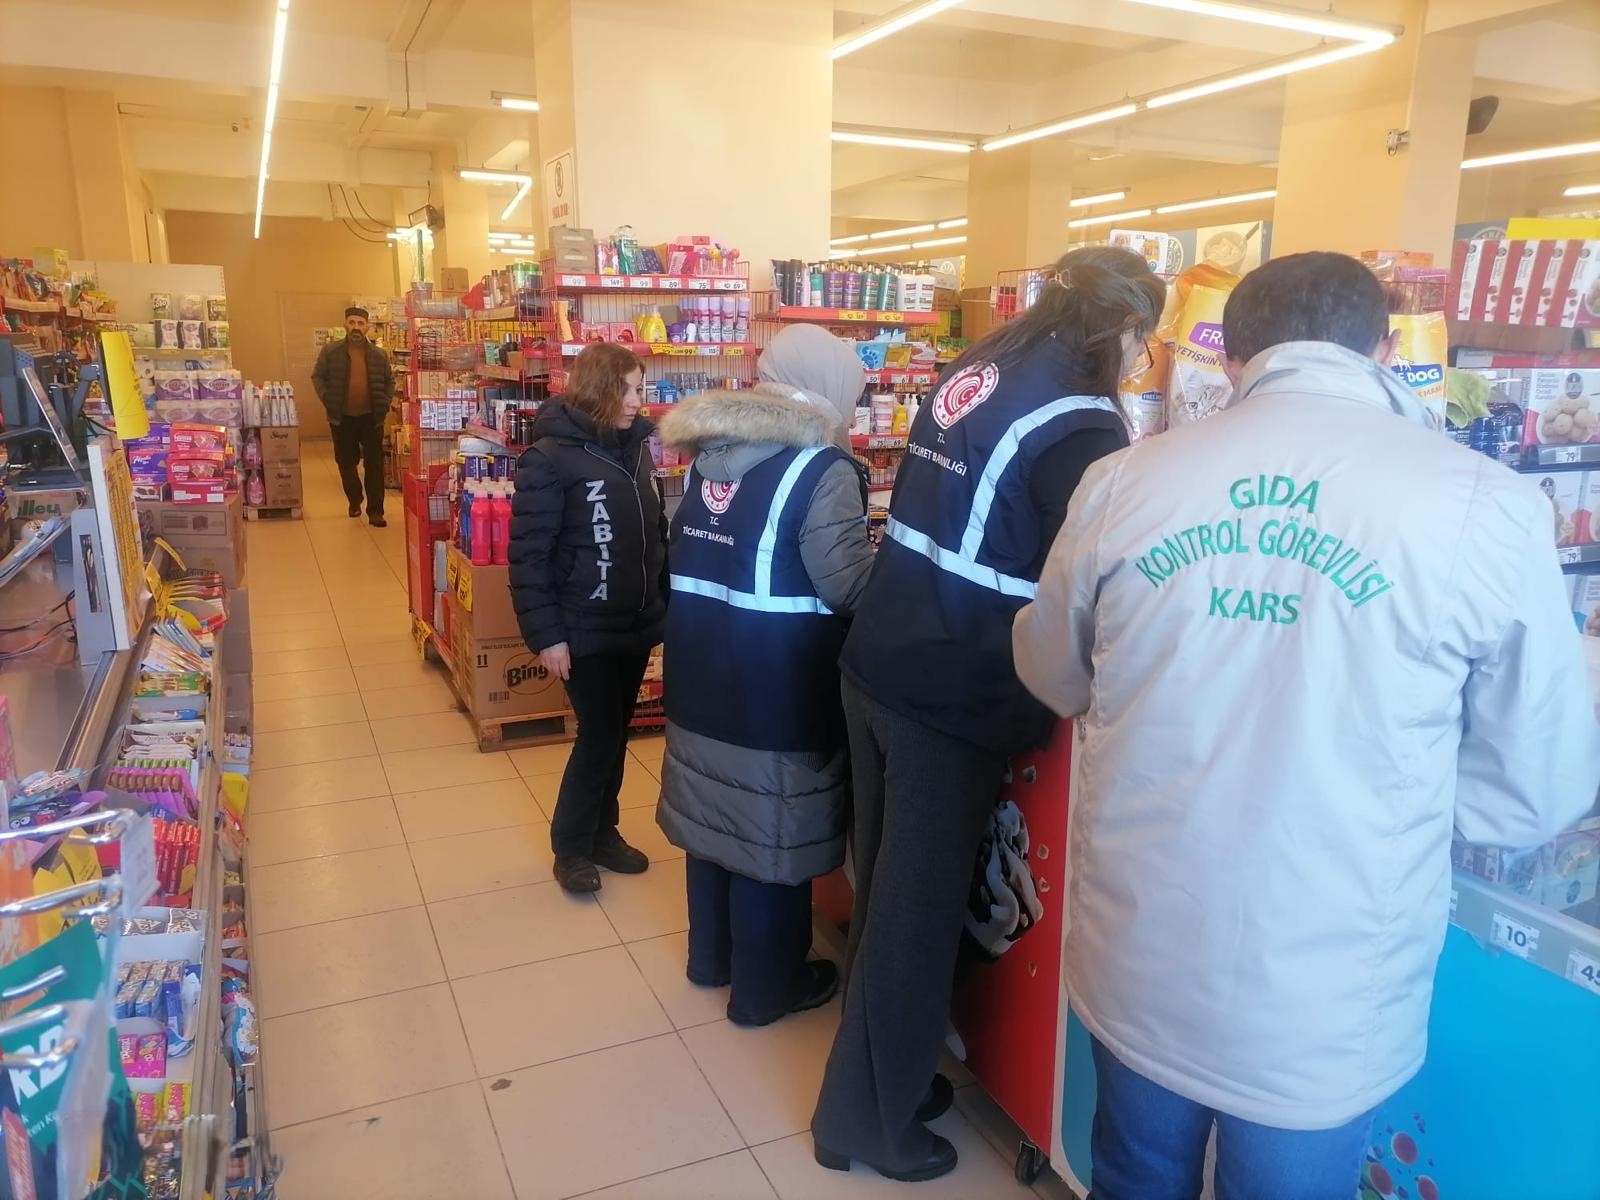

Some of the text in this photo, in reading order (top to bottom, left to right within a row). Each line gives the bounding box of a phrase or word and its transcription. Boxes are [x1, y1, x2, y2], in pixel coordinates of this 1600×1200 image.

[1407, 368, 1440, 383] DOG
[931, 451, 968, 477] BANLIĞI
[1229, 474, 1321, 514] GIDA
[585, 480, 614, 601] ZABITA
[1135, 515, 1396, 609] KONTROL GÖREVLİSİ
[1208, 586, 1302, 625] KARS
[505, 663, 550, 688] Bing
[1506, 924, 1527, 948] 10
